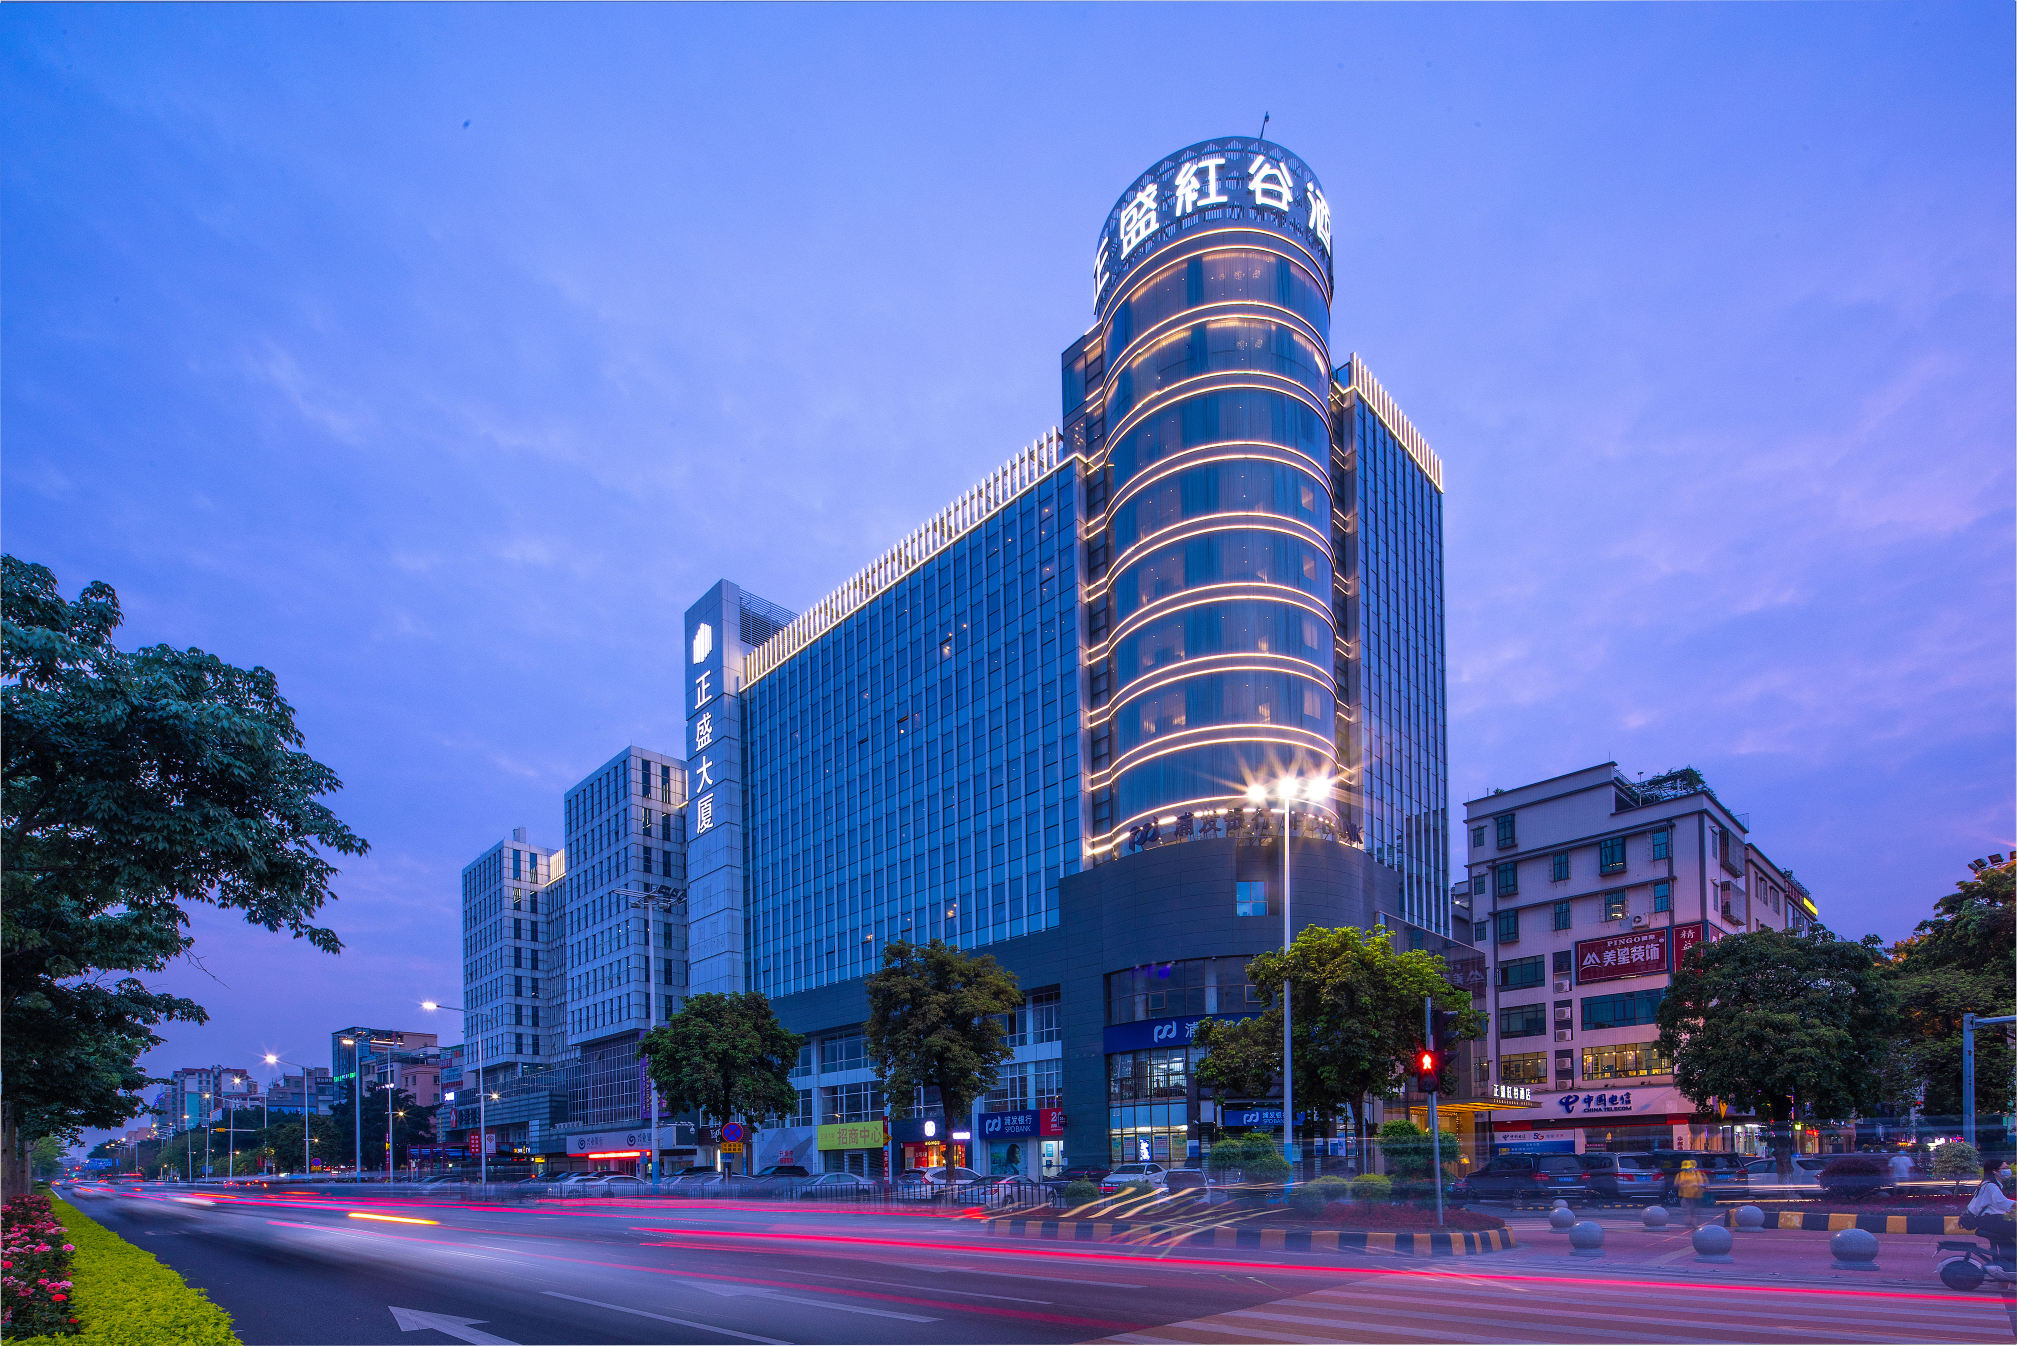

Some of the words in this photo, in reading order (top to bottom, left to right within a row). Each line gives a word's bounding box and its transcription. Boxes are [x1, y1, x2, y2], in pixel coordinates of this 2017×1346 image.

[694, 669, 714, 834] 正盛大厦
[1607, 935, 1641, 947] PINGO
[1603, 943, 1660, 967] 美星装饰
[1583, 1091, 1632, 1108] 中国电信
[837, 1126, 882, 1145] 招商中心
[1533, 1132, 1545, 1140] 5G
